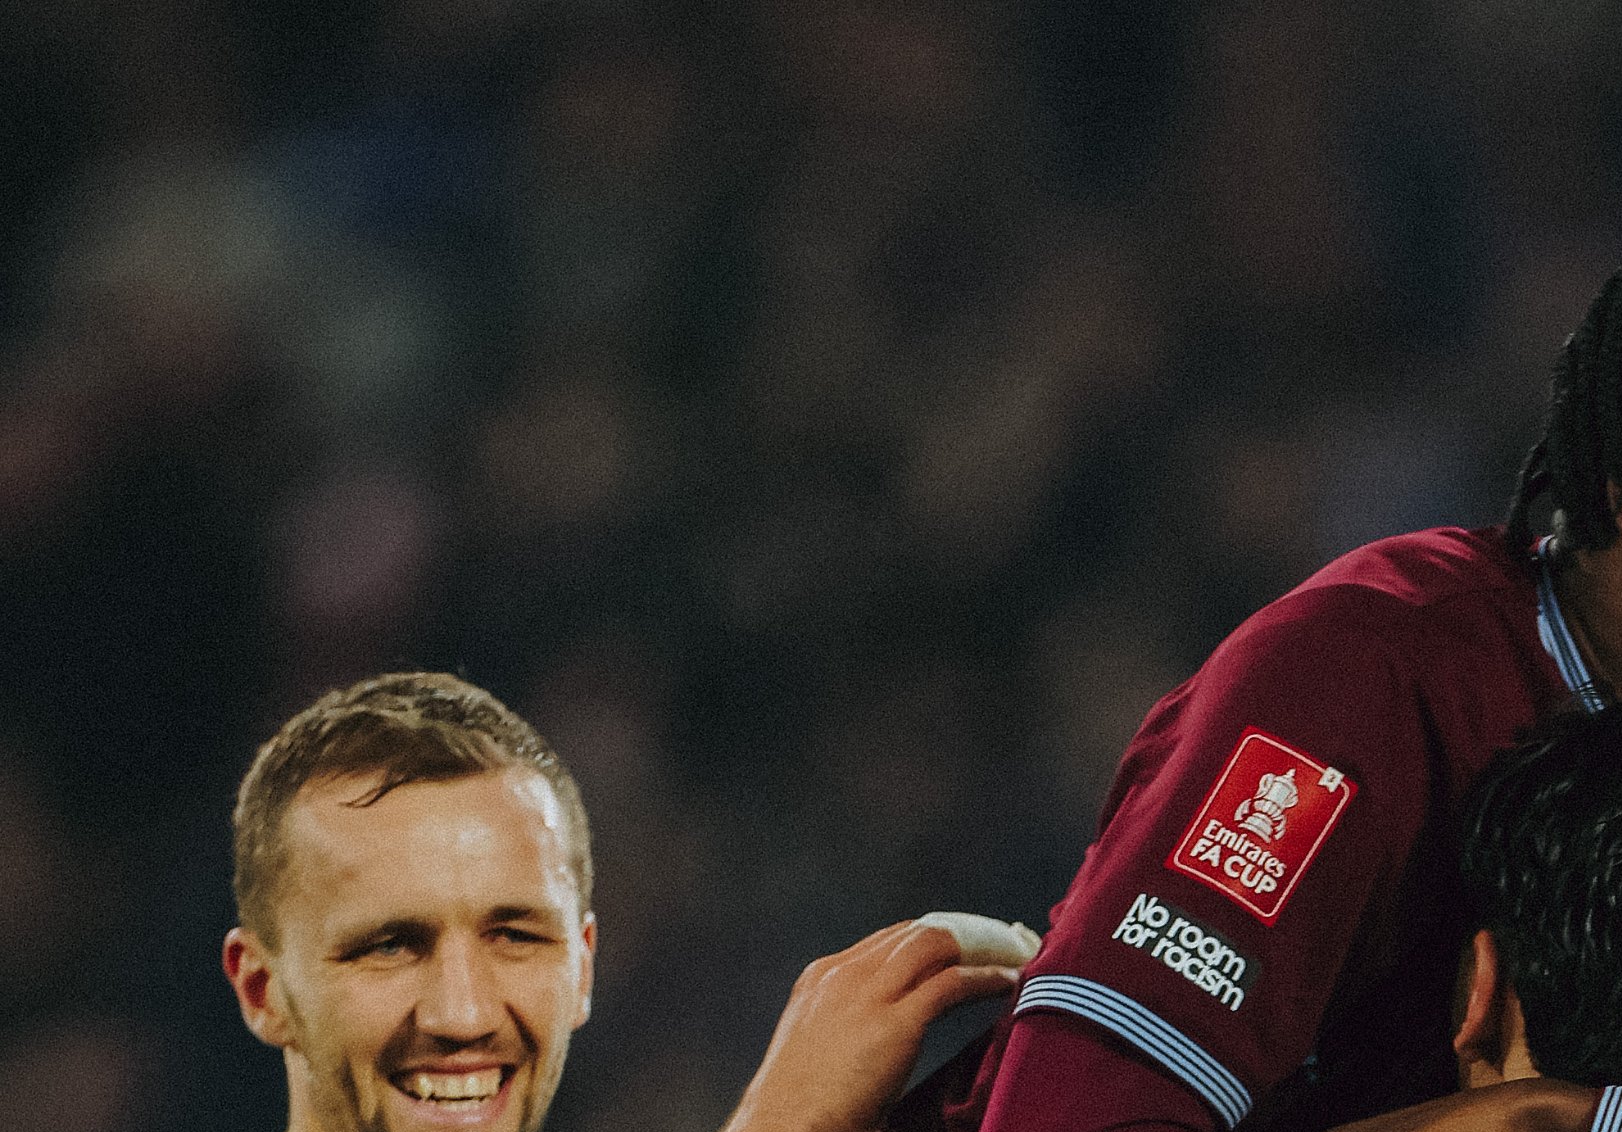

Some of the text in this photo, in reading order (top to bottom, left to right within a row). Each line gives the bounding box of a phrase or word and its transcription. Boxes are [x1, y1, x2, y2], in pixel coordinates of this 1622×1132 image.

[1190, 838, 1278, 894] FA CUP
[1203, 819, 1287, 879] Emirates
[1112, 916, 1246, 1012] for racism
[1128, 893, 1247, 981] No room
